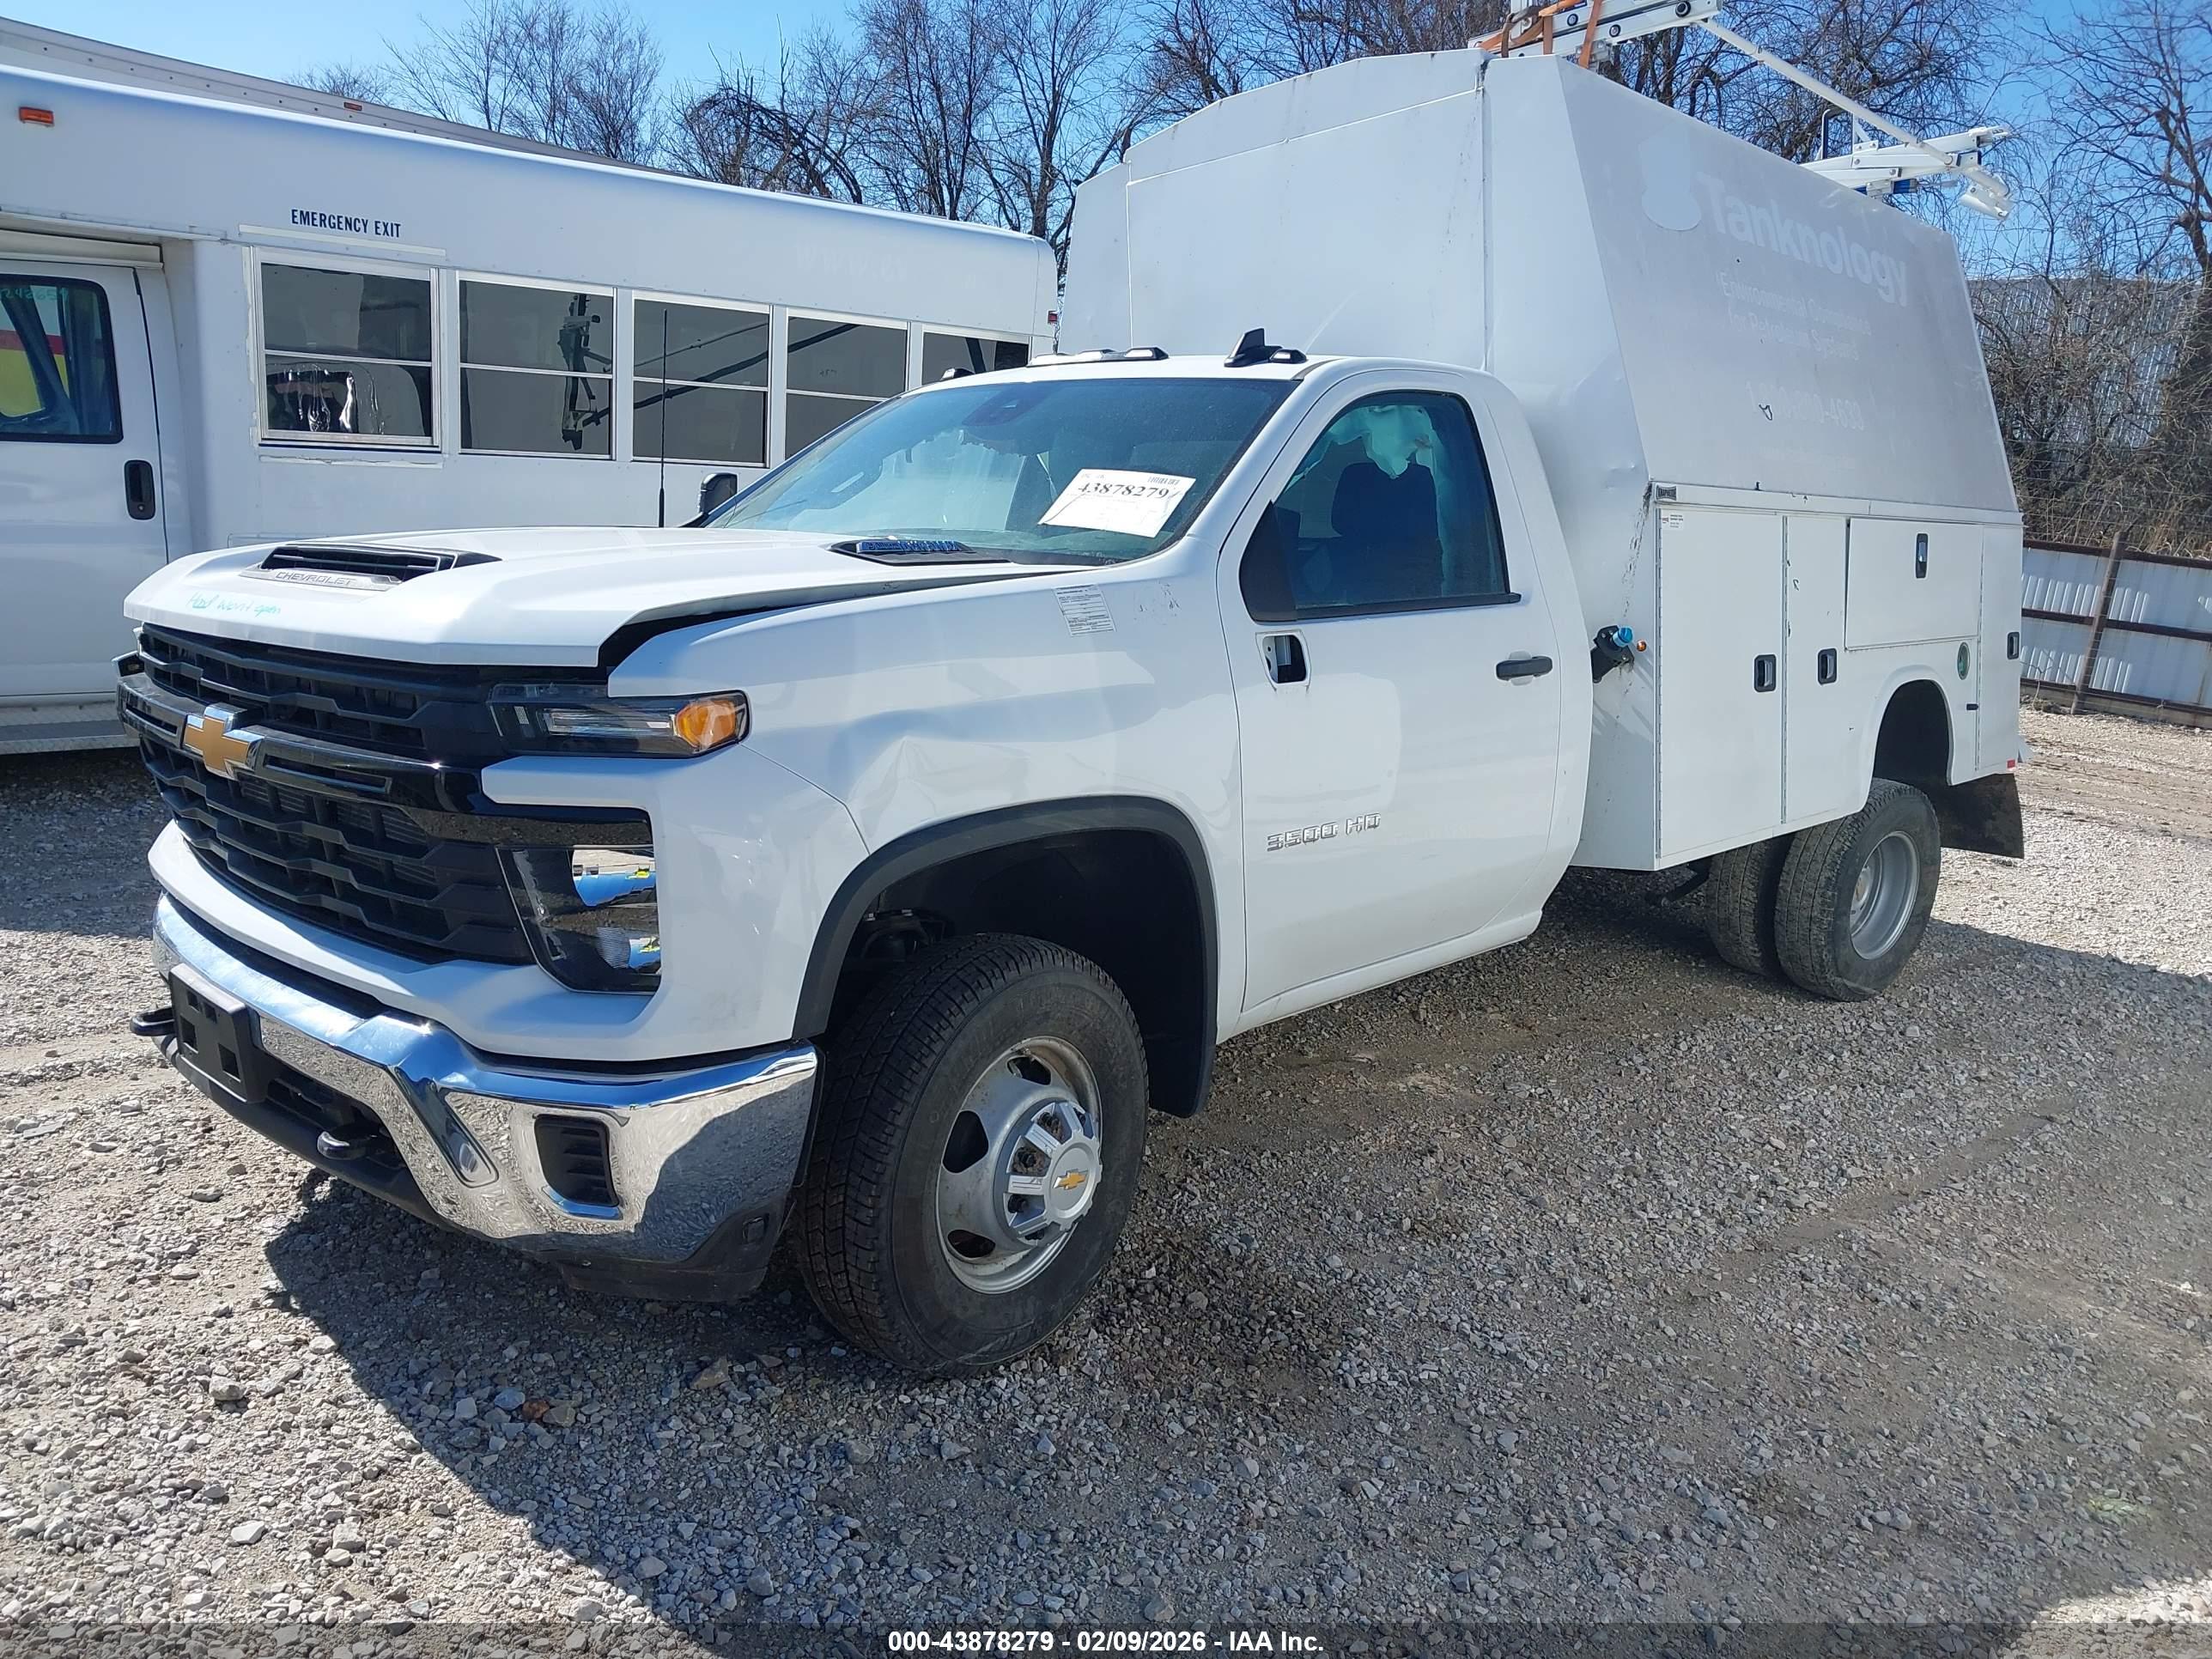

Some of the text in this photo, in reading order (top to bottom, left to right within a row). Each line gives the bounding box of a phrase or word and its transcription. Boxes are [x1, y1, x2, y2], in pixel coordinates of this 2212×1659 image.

[291, 209, 401, 238] EMERGENCY EXIT
[1695, 171, 1909, 307] Tanknology
[1078, 482, 1170, 499] 43878279
[275, 571, 357, 585] CHEVROLET
[1267, 812, 1381, 852] 3500 HD
